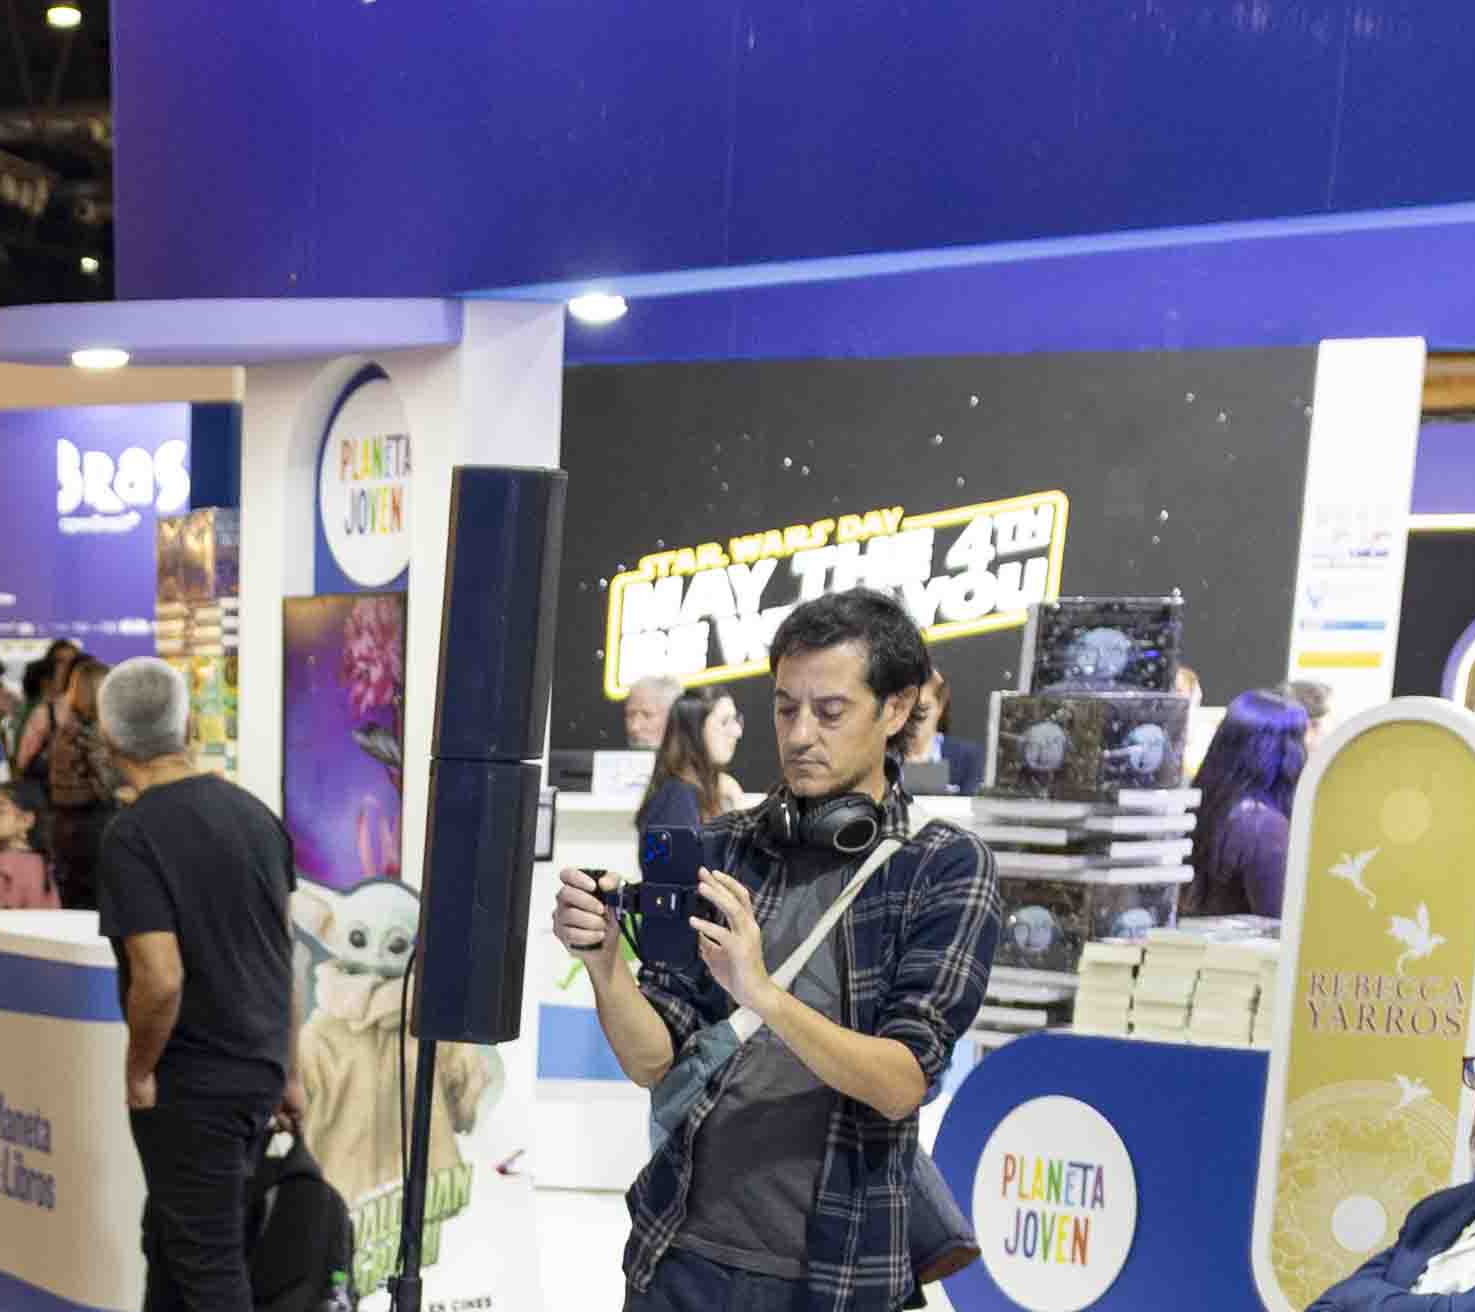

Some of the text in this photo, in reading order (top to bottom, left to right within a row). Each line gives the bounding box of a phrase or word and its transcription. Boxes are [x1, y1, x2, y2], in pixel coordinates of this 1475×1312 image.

[339, 433, 412, 482] PLANETA
[344, 486, 404, 535] JOVEN
[836, 505, 905, 544] DAY
[621, 557, 779, 634] MAY
[791, 526, 936, 603] THE
[946, 502, 1055, 573] 4TH
[904, 557, 1048, 630] YOU
[1310, 972, 1465, 1005] REBECCA
[1307, 1000, 1465, 1040] YARROS
[1000, 1152, 1106, 1209] PLANETA
[1003, 1207, 1090, 1267] JOVEN
